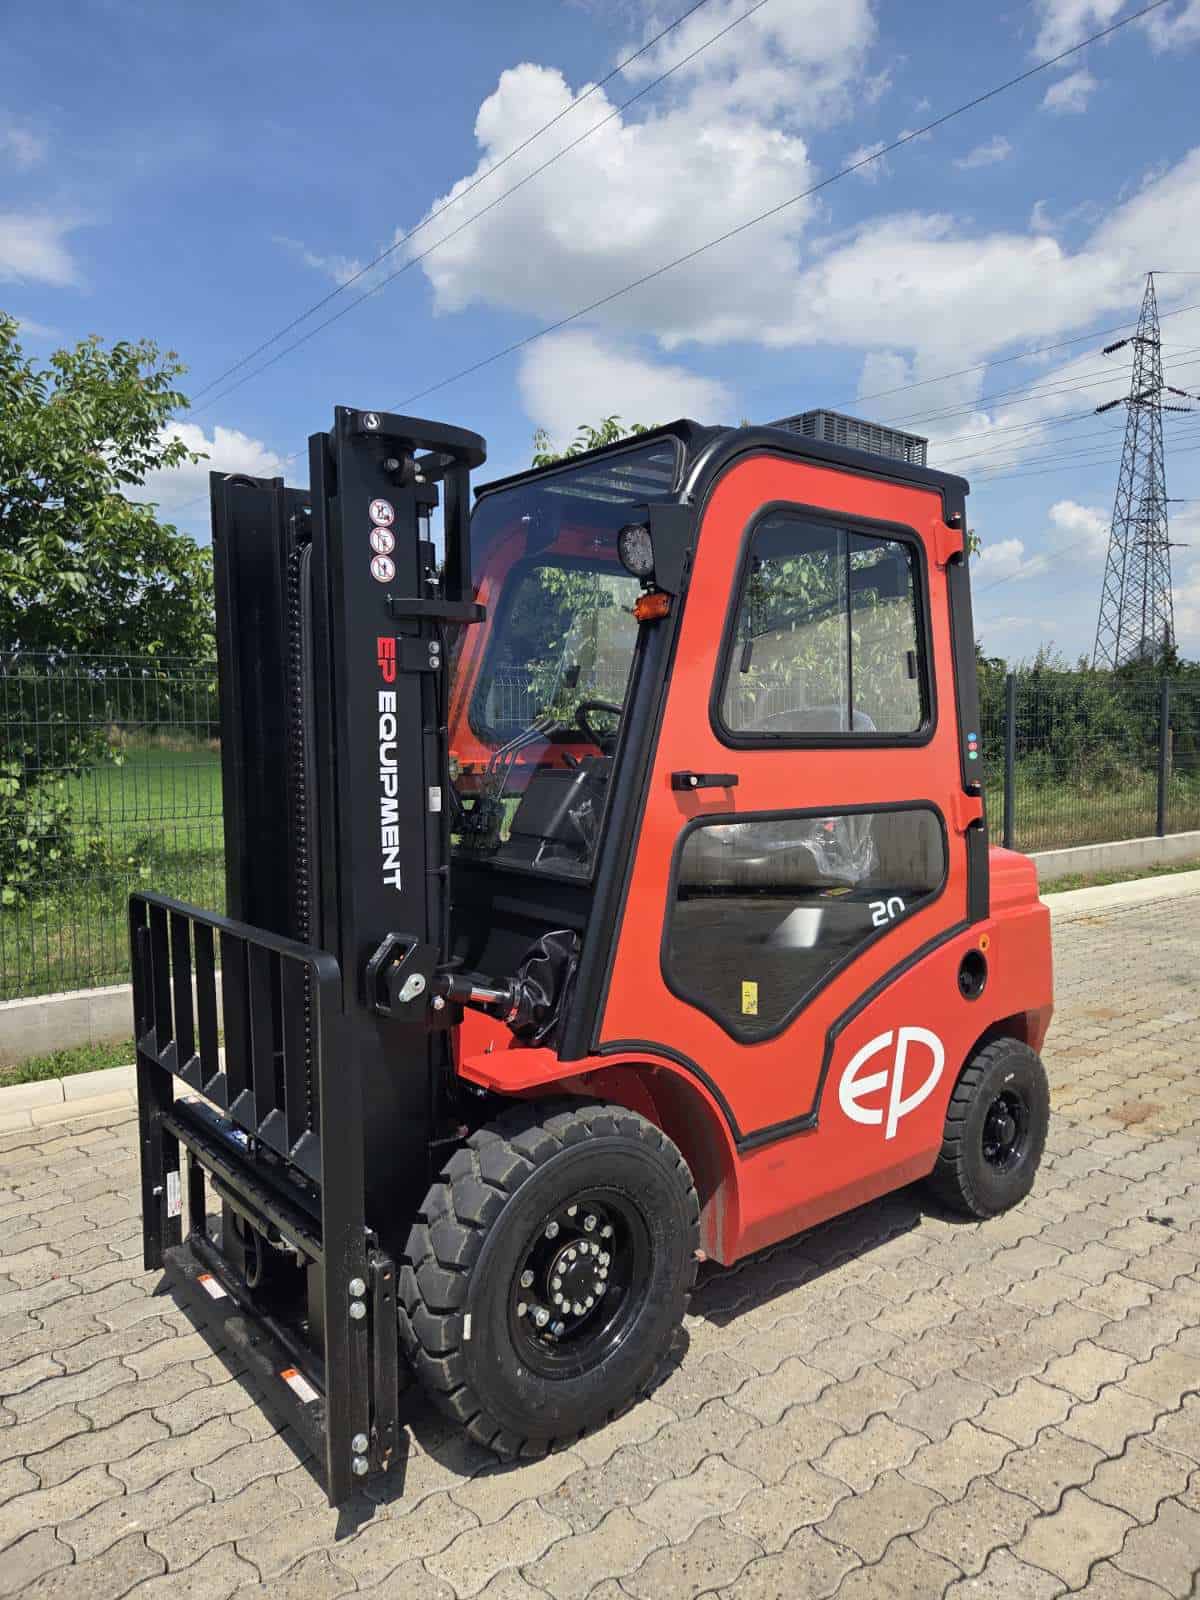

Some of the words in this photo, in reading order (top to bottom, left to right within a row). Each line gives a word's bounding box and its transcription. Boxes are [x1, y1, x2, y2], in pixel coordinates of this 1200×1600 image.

[377, 637, 396, 682] EP
[378, 691, 401, 891] EQUIPMENT
[838, 1026, 945, 1140] EP
